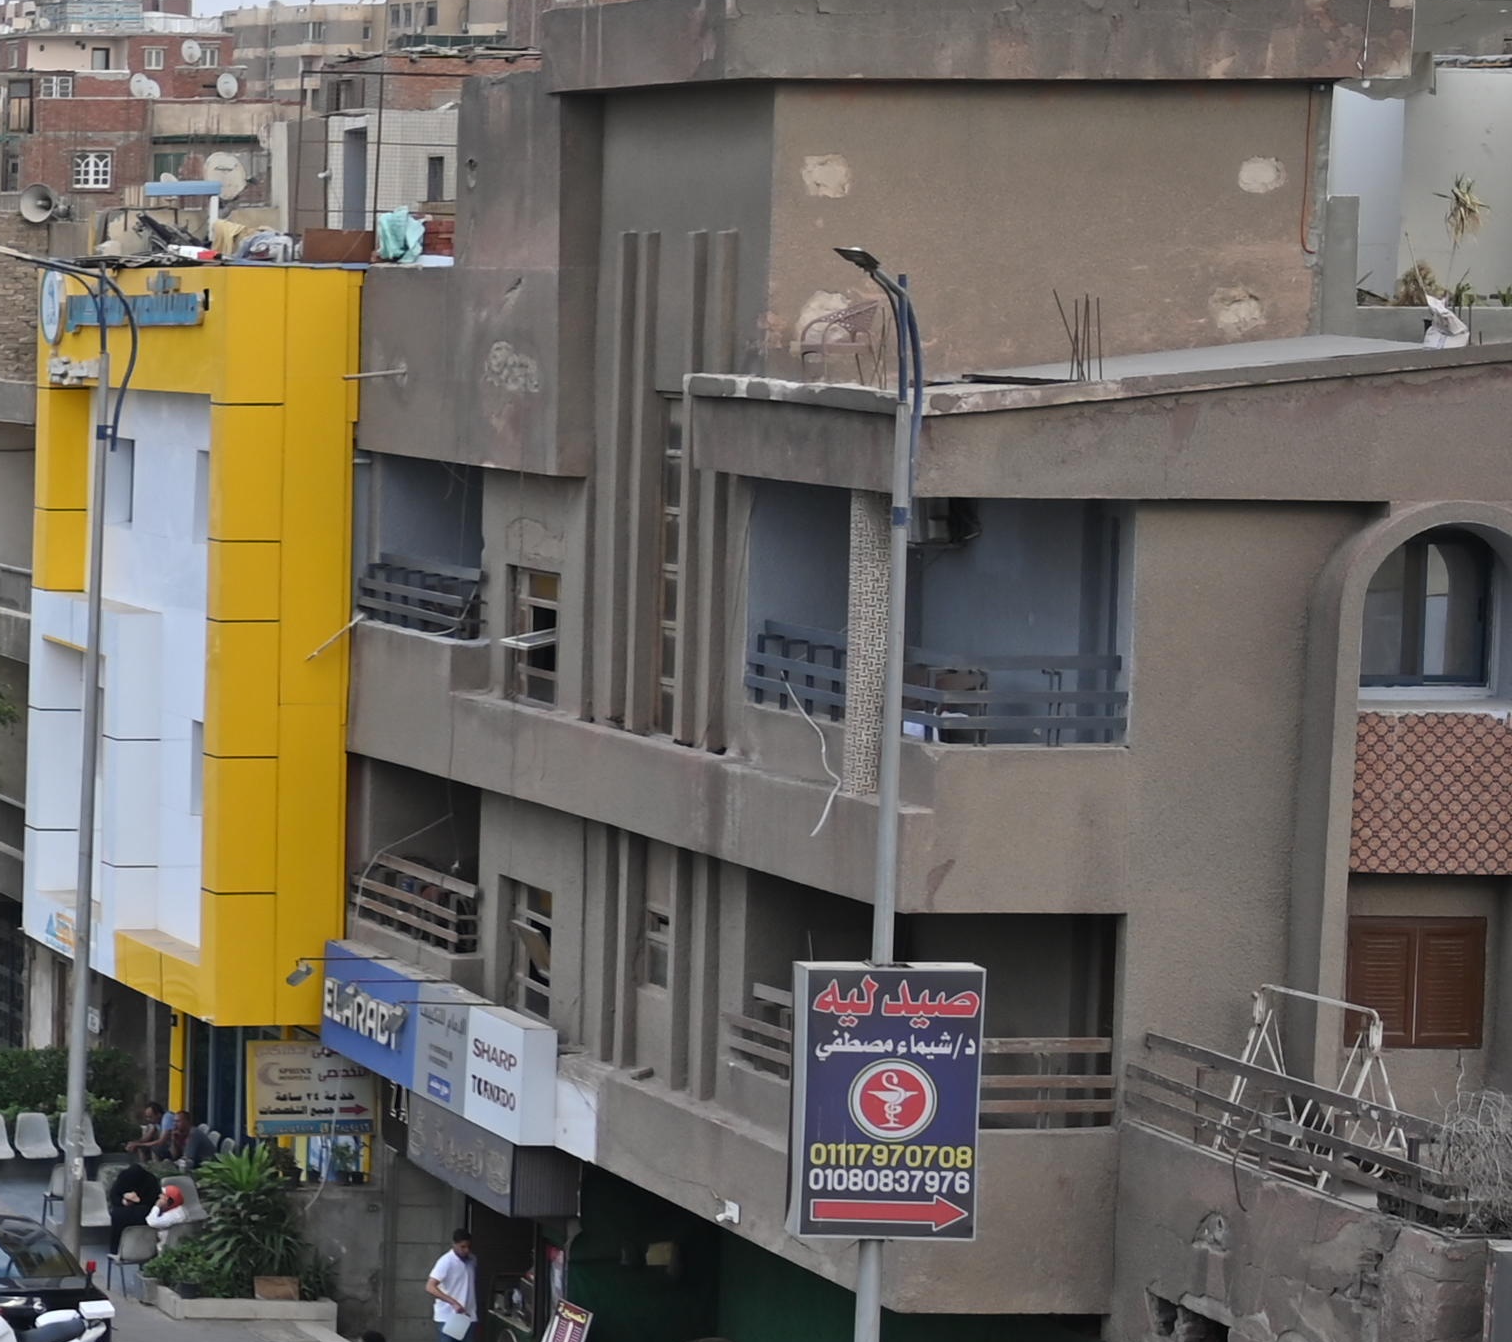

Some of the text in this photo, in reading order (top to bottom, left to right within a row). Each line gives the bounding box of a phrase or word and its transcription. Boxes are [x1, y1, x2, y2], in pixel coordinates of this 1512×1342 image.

[472, 1038, 517, 1072] SHARP
[471, 1074, 516, 1111] TORNADO
[810, 1143, 972, 1169] 01117970708
[808, 1168, 970, 1194] 01080837976
